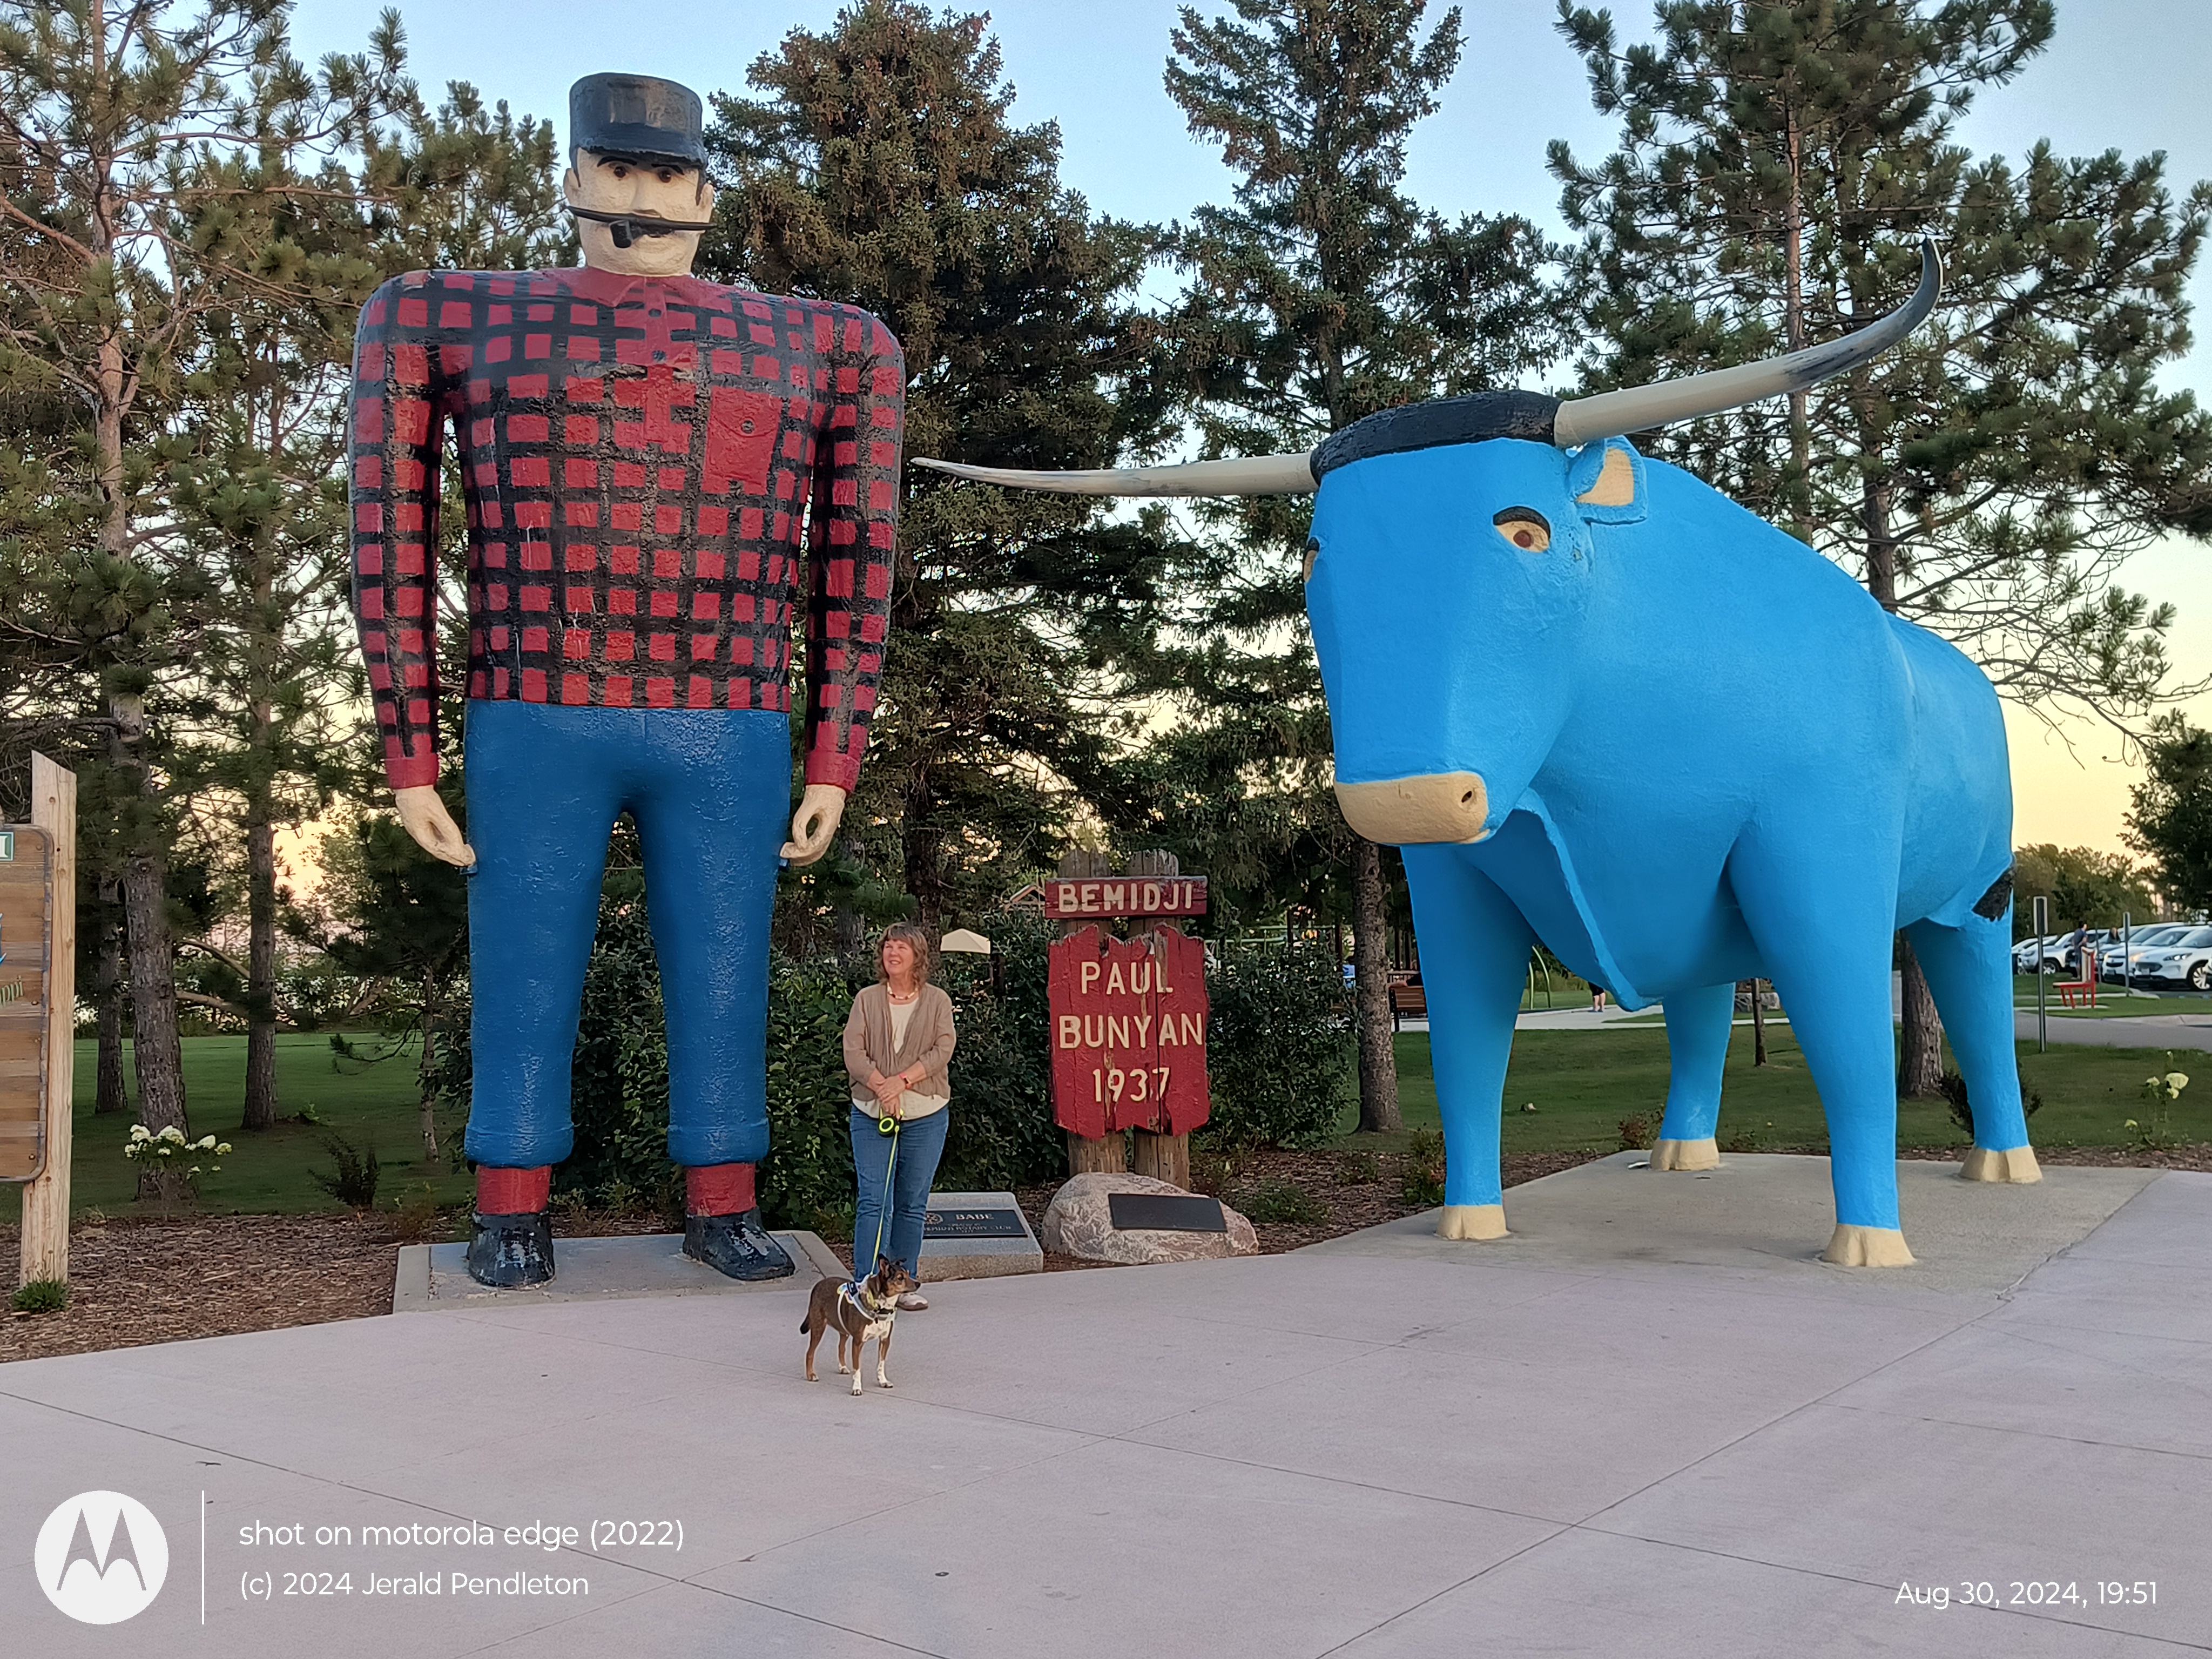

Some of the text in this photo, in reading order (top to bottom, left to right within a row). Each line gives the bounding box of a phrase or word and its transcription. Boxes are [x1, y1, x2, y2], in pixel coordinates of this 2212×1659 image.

[1058, 882, 1192, 913] BEMIDJI
[1081, 961, 1174, 995] PAUL
[1058, 1013, 1203, 1049] BUNYAN
[1092, 1067, 1170, 1103] 1937
